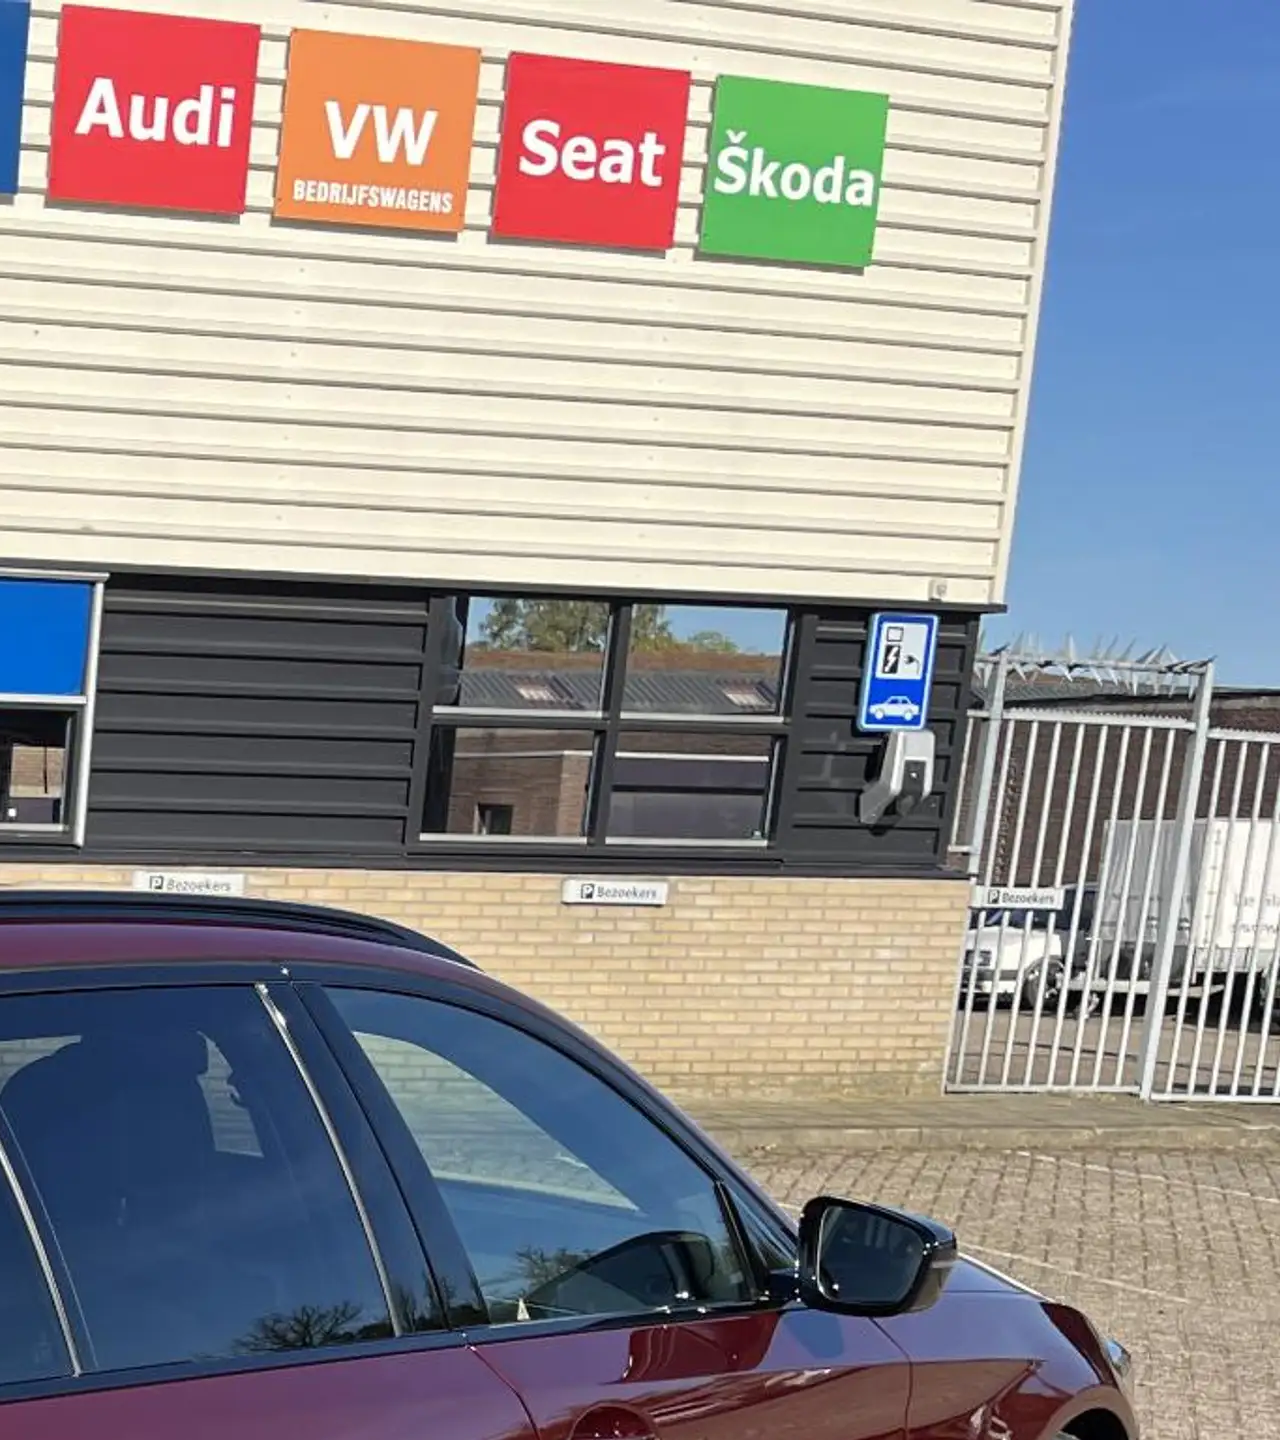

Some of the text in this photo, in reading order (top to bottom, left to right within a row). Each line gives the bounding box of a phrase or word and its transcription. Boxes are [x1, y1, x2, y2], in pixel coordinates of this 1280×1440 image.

[75, 77, 235, 147] Audi
[324, 100, 438, 166] VW
[519, 119, 666, 188] Seat
[714, 129, 874, 207] Škoda
[293, 179, 453, 214] BEDRIJFSWAGENS
[167, 878, 231, 892] Bezoekers
[597, 885, 657, 899] Bezoekers
[1002, 892, 1055, 904] Bezoekers
